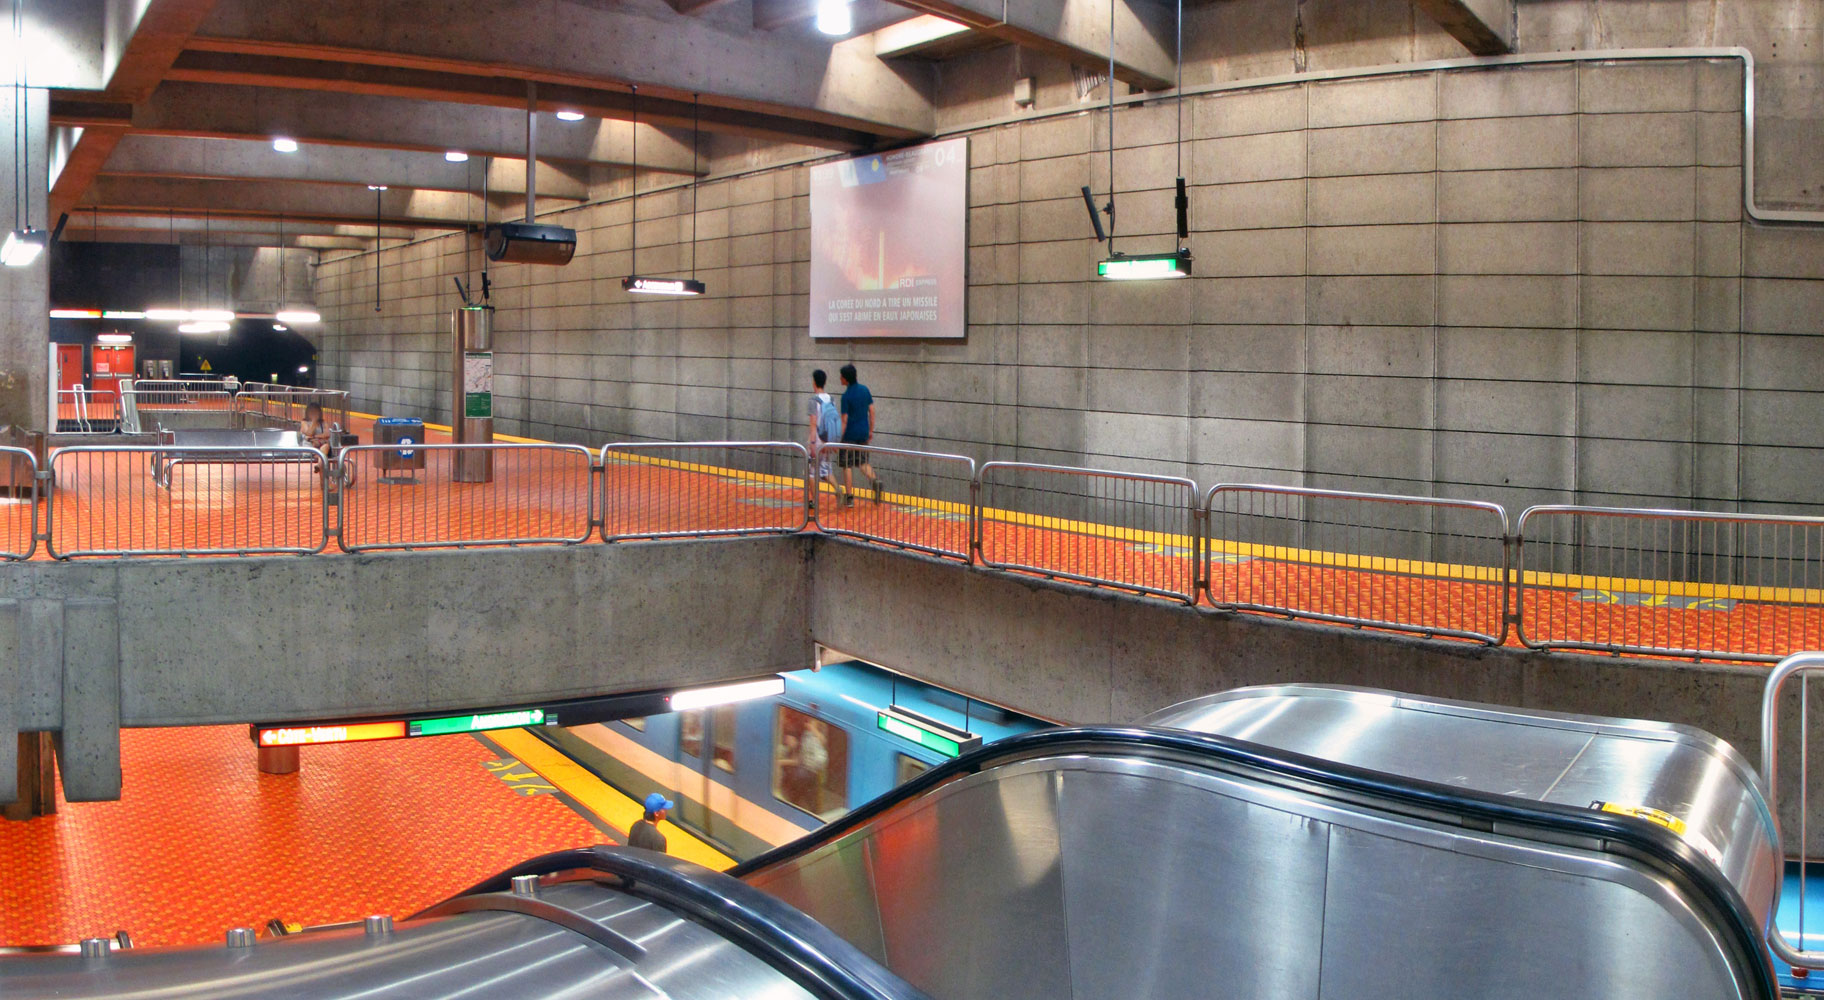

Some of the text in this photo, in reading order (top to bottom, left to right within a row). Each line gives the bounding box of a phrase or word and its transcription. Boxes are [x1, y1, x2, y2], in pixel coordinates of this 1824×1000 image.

[935, 145, 955, 167] 04
[900, 278, 914, 288] RDI
[828, 300, 836, 310] LA
[855, 299, 864, 309] DU
[864, 297, 881, 309] NORD
[902, 297, 911, 307] UN
[912, 296, 938, 307] MISSILE
[828, 312, 839, 322] QUI
[839, 311, 853, 322] S'EST
[873, 311, 881, 321] EN
[882, 310, 898, 320] EAUX
[899, 309, 937, 320] JAPONAISES
